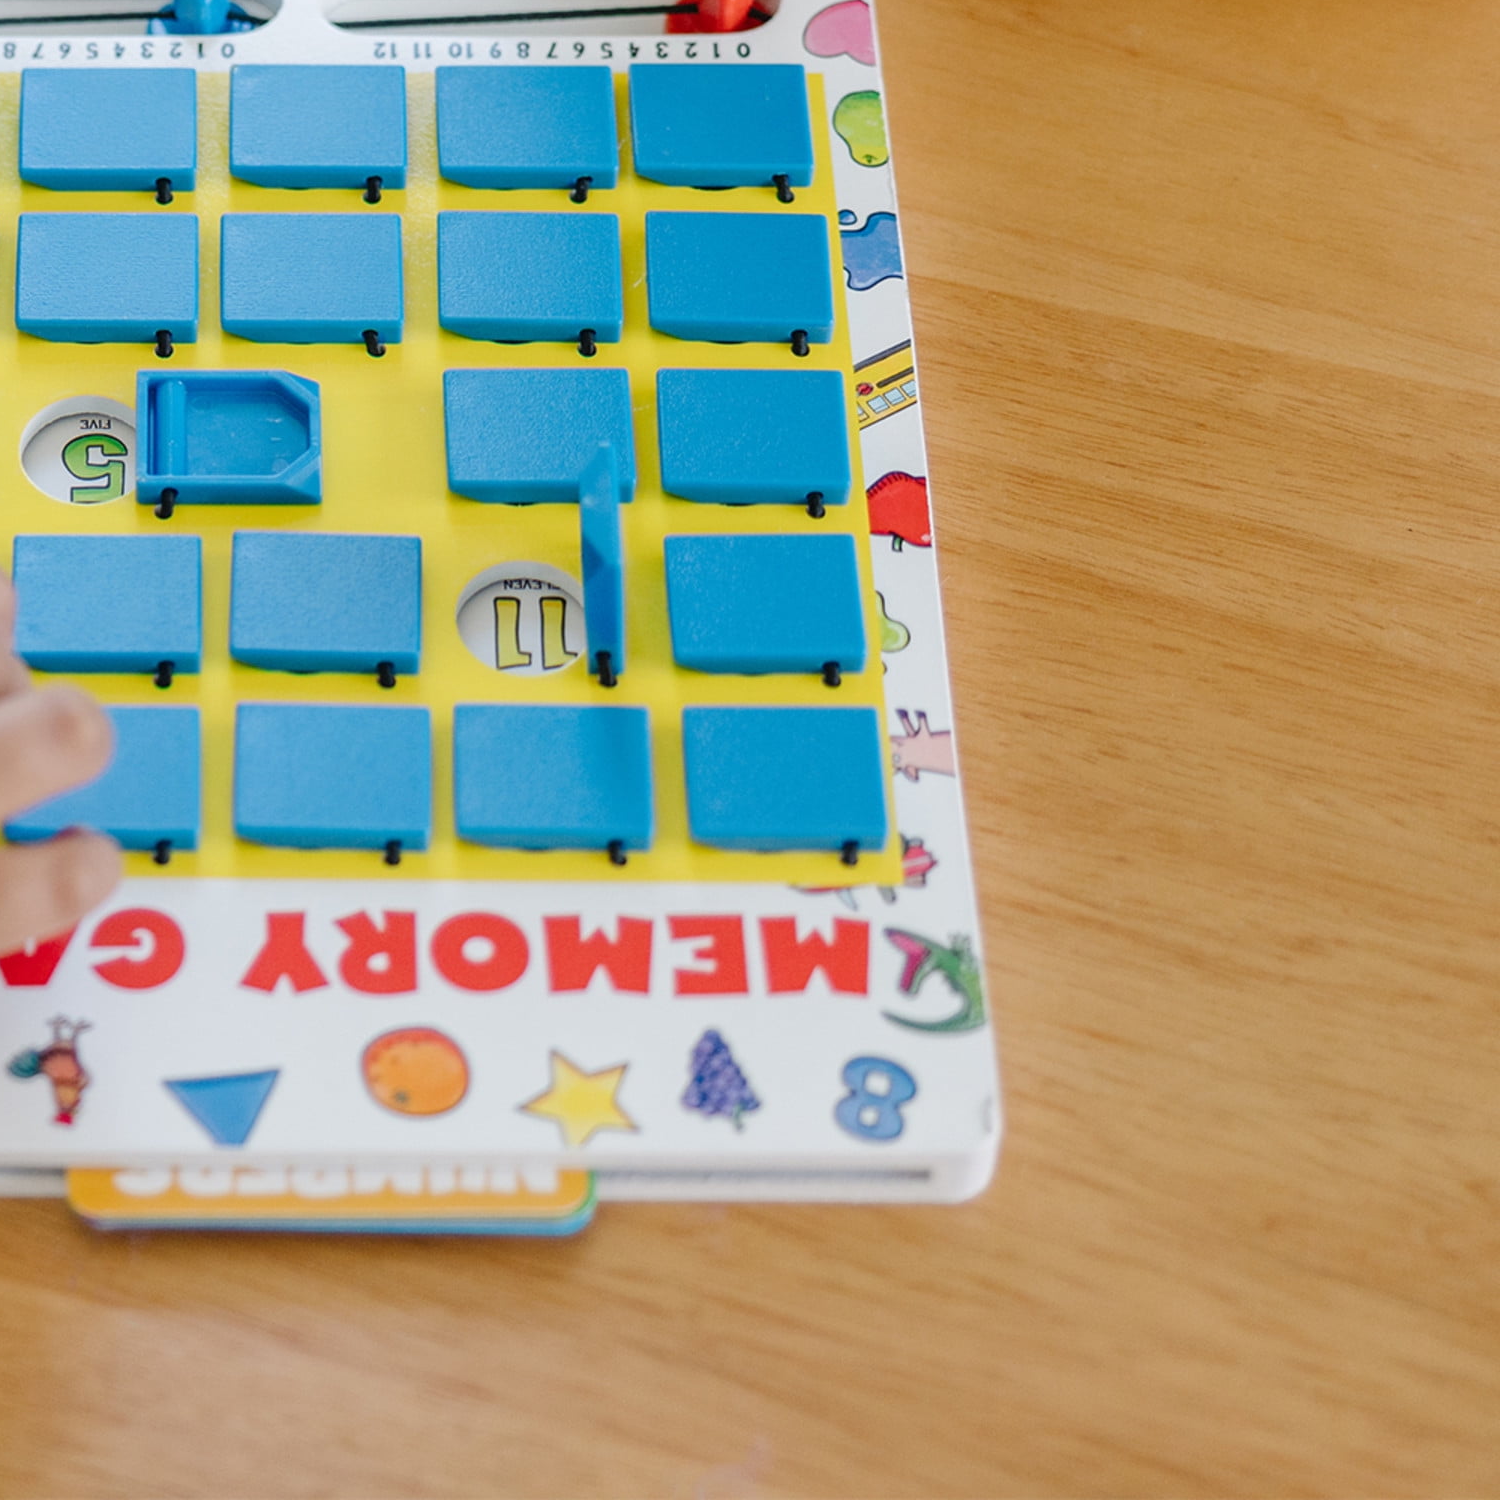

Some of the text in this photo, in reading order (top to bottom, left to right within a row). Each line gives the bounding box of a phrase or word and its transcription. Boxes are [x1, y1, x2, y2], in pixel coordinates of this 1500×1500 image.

[2, 41, 18, 61] 8
[30, 41, 45, 61] 7
[58, 41, 72, 61] 6
[85, 41, 100, 61] 5
[113, 41, 127, 61] 4
[139, 41, 155, 61] 3
[168, 41, 183, 60] 2
[196, 41, 207, 61] 1
[220, 41, 236, 60] 0
[372, 40, 752, 61] 0 1 2 3 4 5 6 7 8 9 10 11 12
[79, 418, 113, 430] FIVE
[61, 433, 129, 504] 5
[493, 596, 579, 671] 11
[239, 908, 871, 997] MEMORY
[834, 1054, 918, 1142] 8
